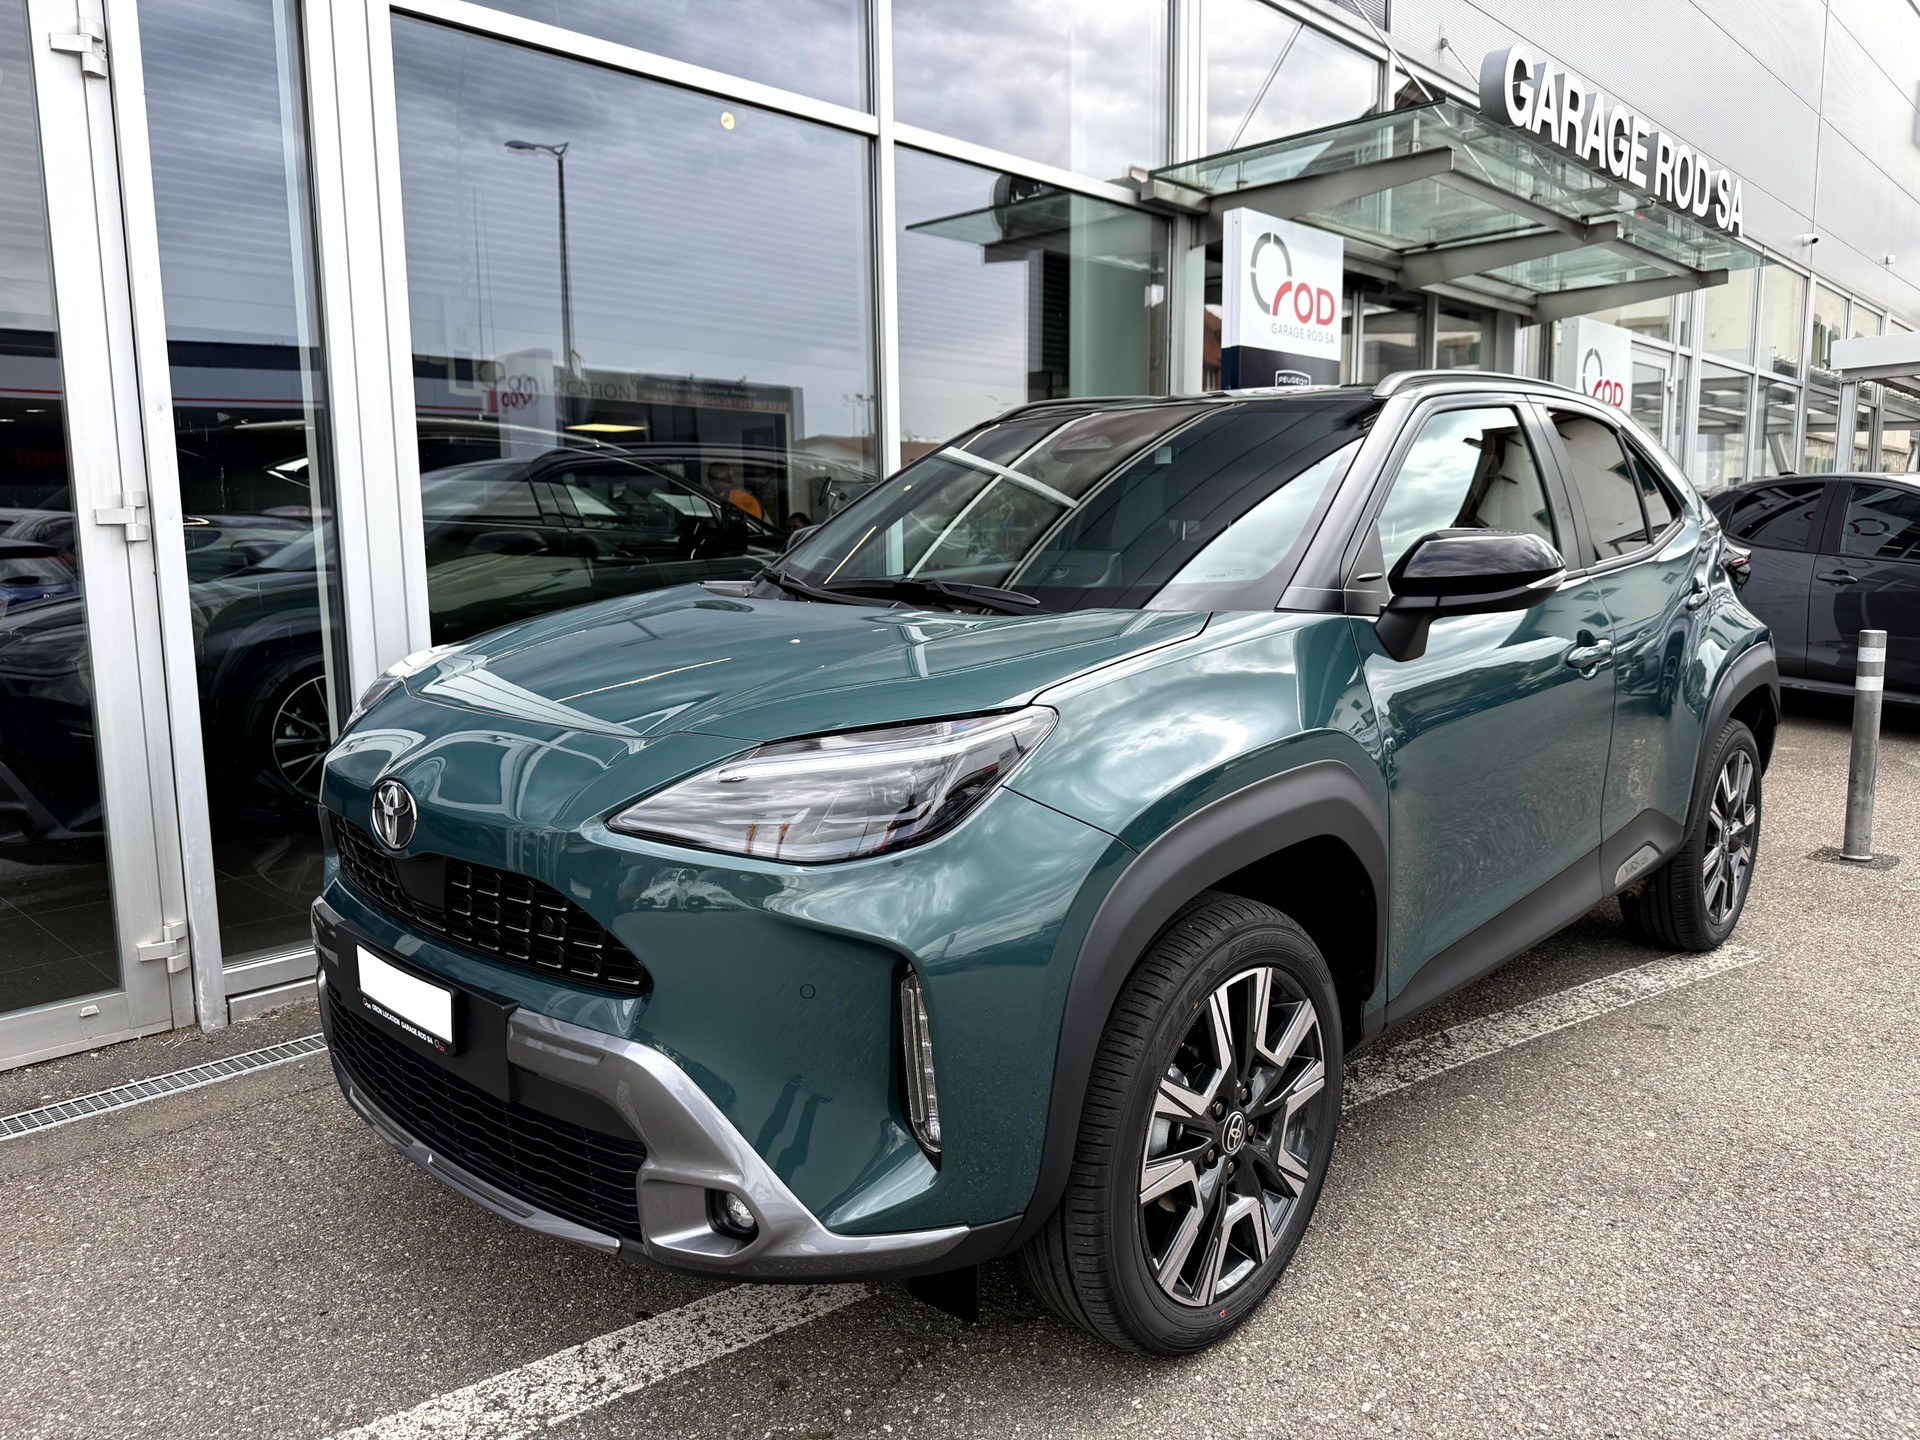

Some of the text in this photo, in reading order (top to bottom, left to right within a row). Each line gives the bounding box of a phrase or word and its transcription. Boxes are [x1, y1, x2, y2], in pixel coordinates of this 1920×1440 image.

[1503, 43, 1744, 237] GARAGE ROD SA
[1271, 322, 1335, 345] GARAGE ROD SA
[1278, 375, 1309, 386] PEUGEOT
[382, 1010, 401, 1026] LOCATION
[401, 1021, 418, 1036] GARAGE
[418, 1030, 427, 1041] ROD
